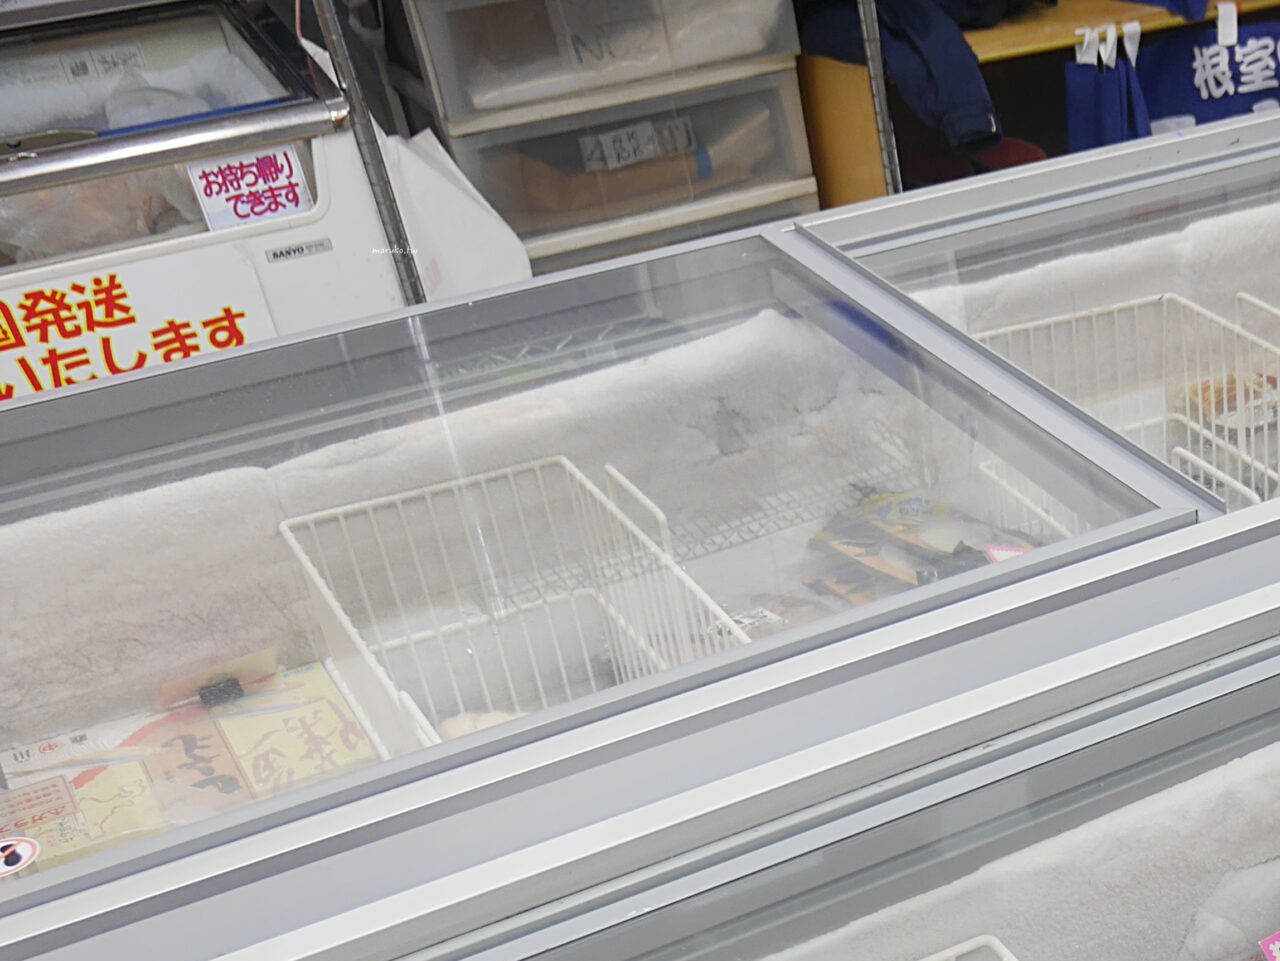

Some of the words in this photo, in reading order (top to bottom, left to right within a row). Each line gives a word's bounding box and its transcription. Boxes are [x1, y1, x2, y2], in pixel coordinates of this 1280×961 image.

[199, 152, 294, 198] お持ち帰り
[226, 181, 300, 219] できます
